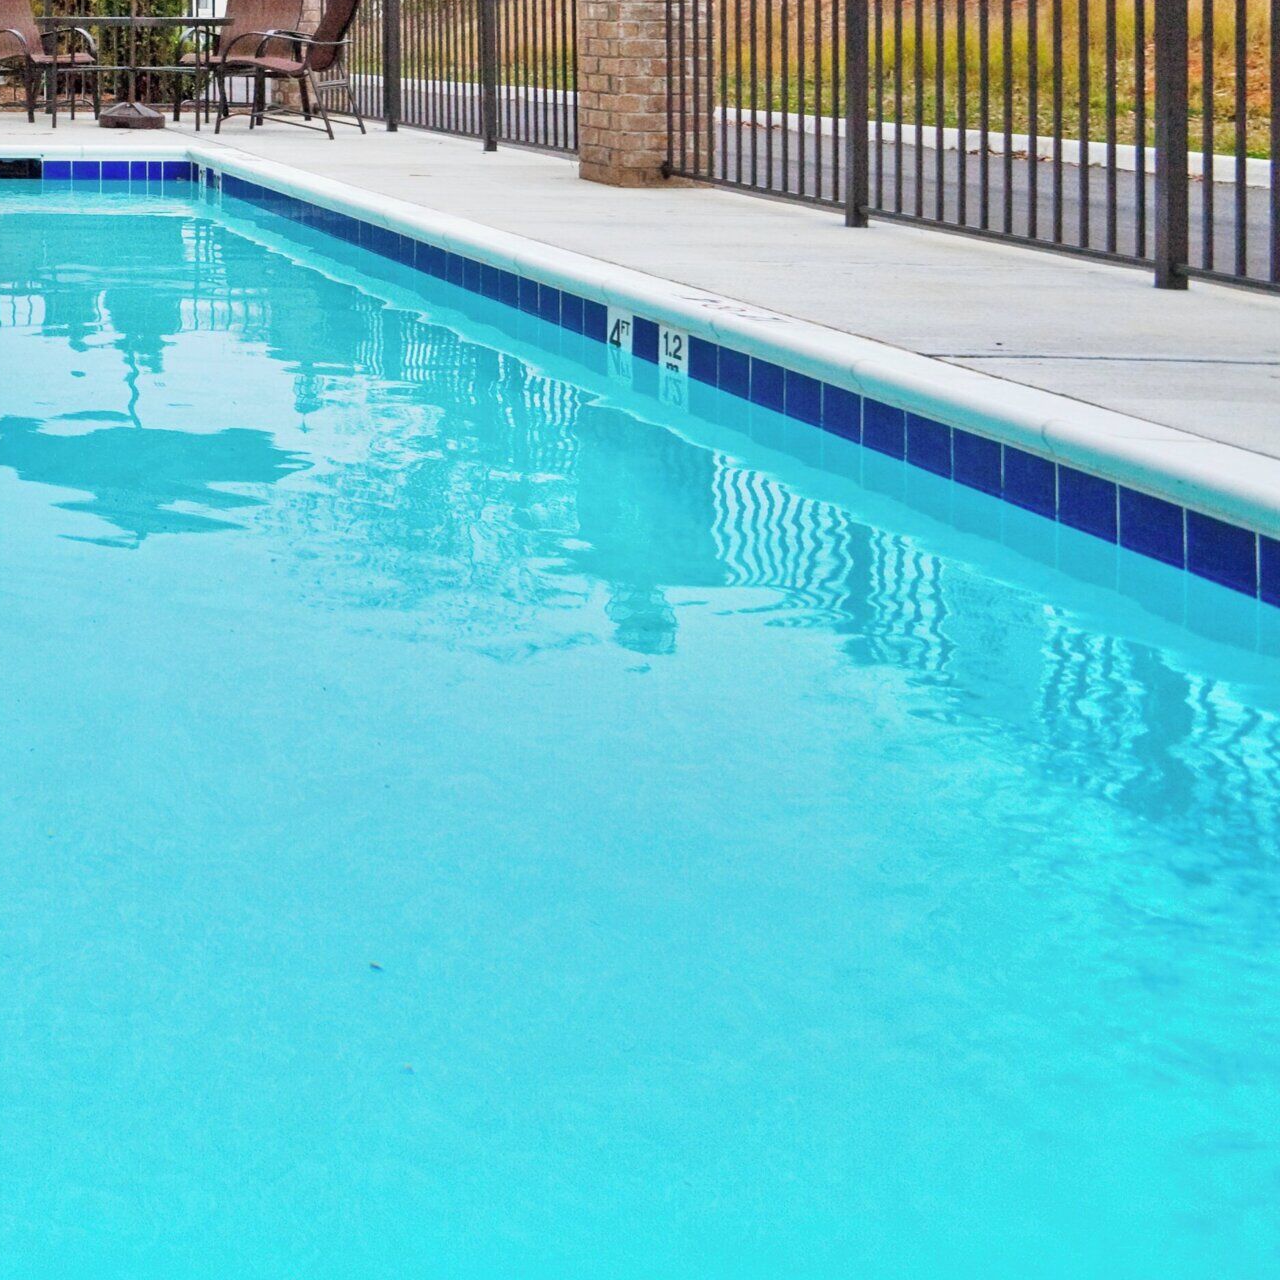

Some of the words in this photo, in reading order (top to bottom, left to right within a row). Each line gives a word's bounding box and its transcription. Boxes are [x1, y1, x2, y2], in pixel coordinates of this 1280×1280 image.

[609, 319, 621, 348] 4
[621, 320, 630, 336] FT
[664, 331, 682, 360] 1.2
